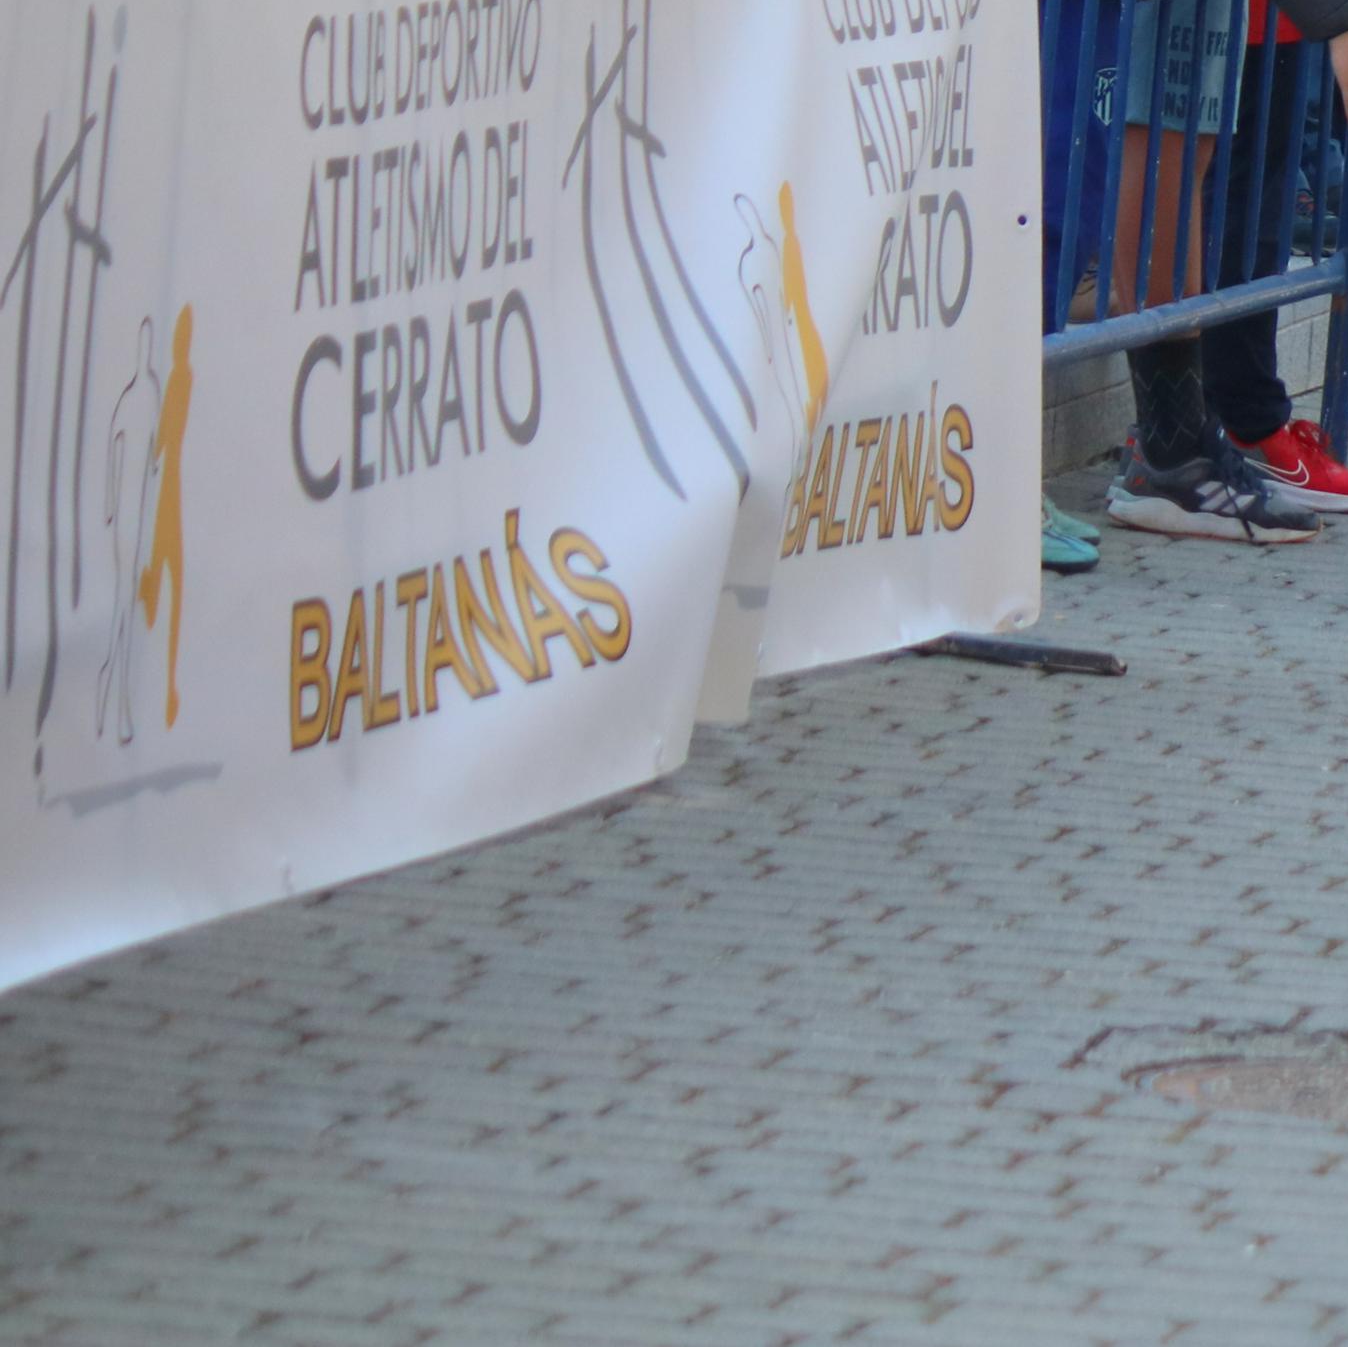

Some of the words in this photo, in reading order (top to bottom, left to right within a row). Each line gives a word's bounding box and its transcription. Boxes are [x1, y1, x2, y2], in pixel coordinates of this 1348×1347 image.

[300, 10, 386, 131] CLUB
[294, 129, 471, 313] ATLETISMO
[481, 119, 534, 271] DEL
[290, 288, 542, 502] CERRATO
[290, 507, 633, 752] BALTANÁS
